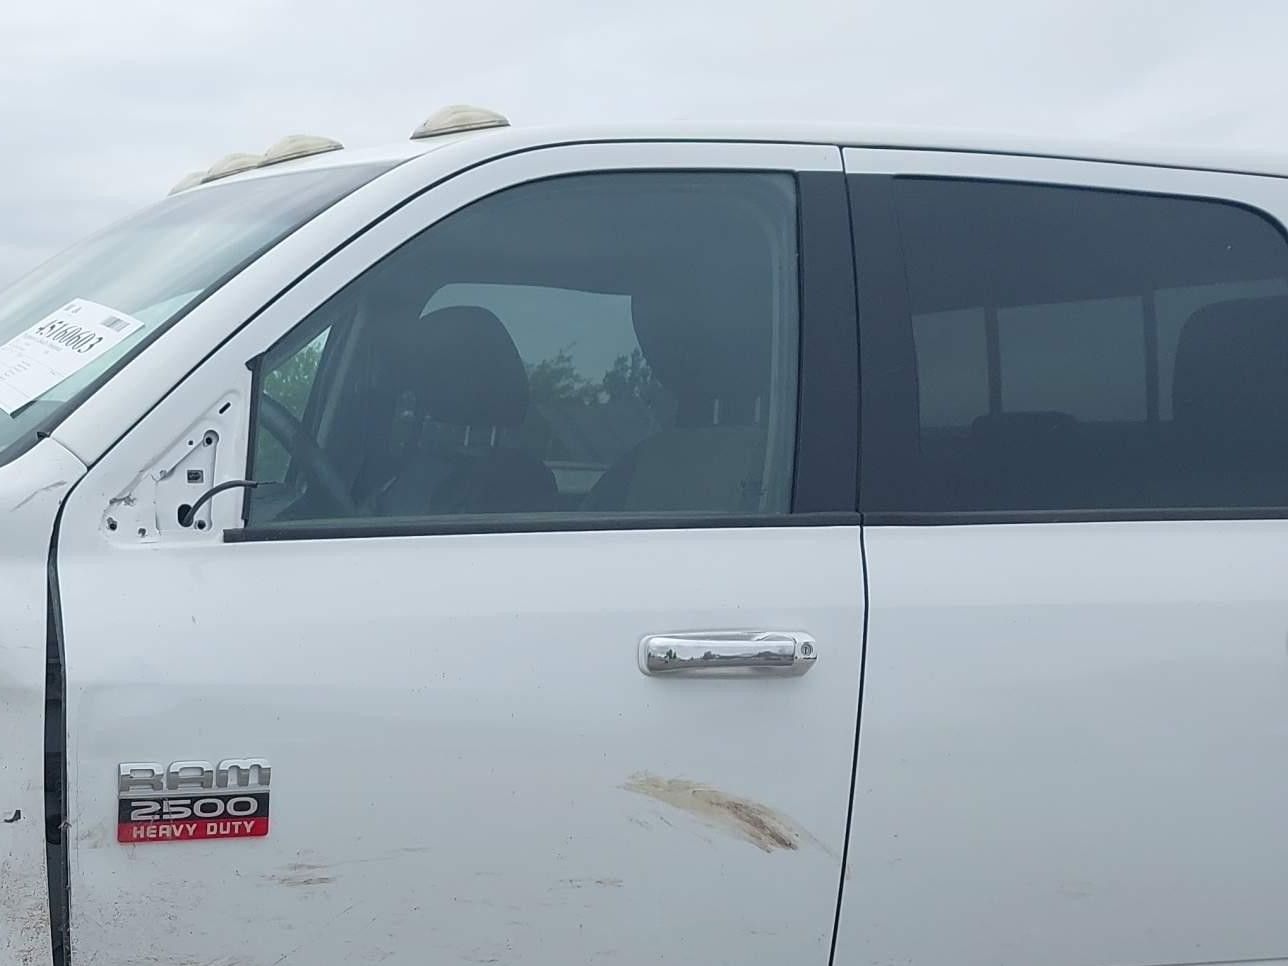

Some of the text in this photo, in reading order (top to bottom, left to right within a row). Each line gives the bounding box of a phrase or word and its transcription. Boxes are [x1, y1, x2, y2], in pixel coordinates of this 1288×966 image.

[35, 319, 104, 354] 45160603
[118, 757, 272, 793] RAM
[130, 796, 258, 821] 2500
[132, 820, 255, 839] HEAVY DUTY
